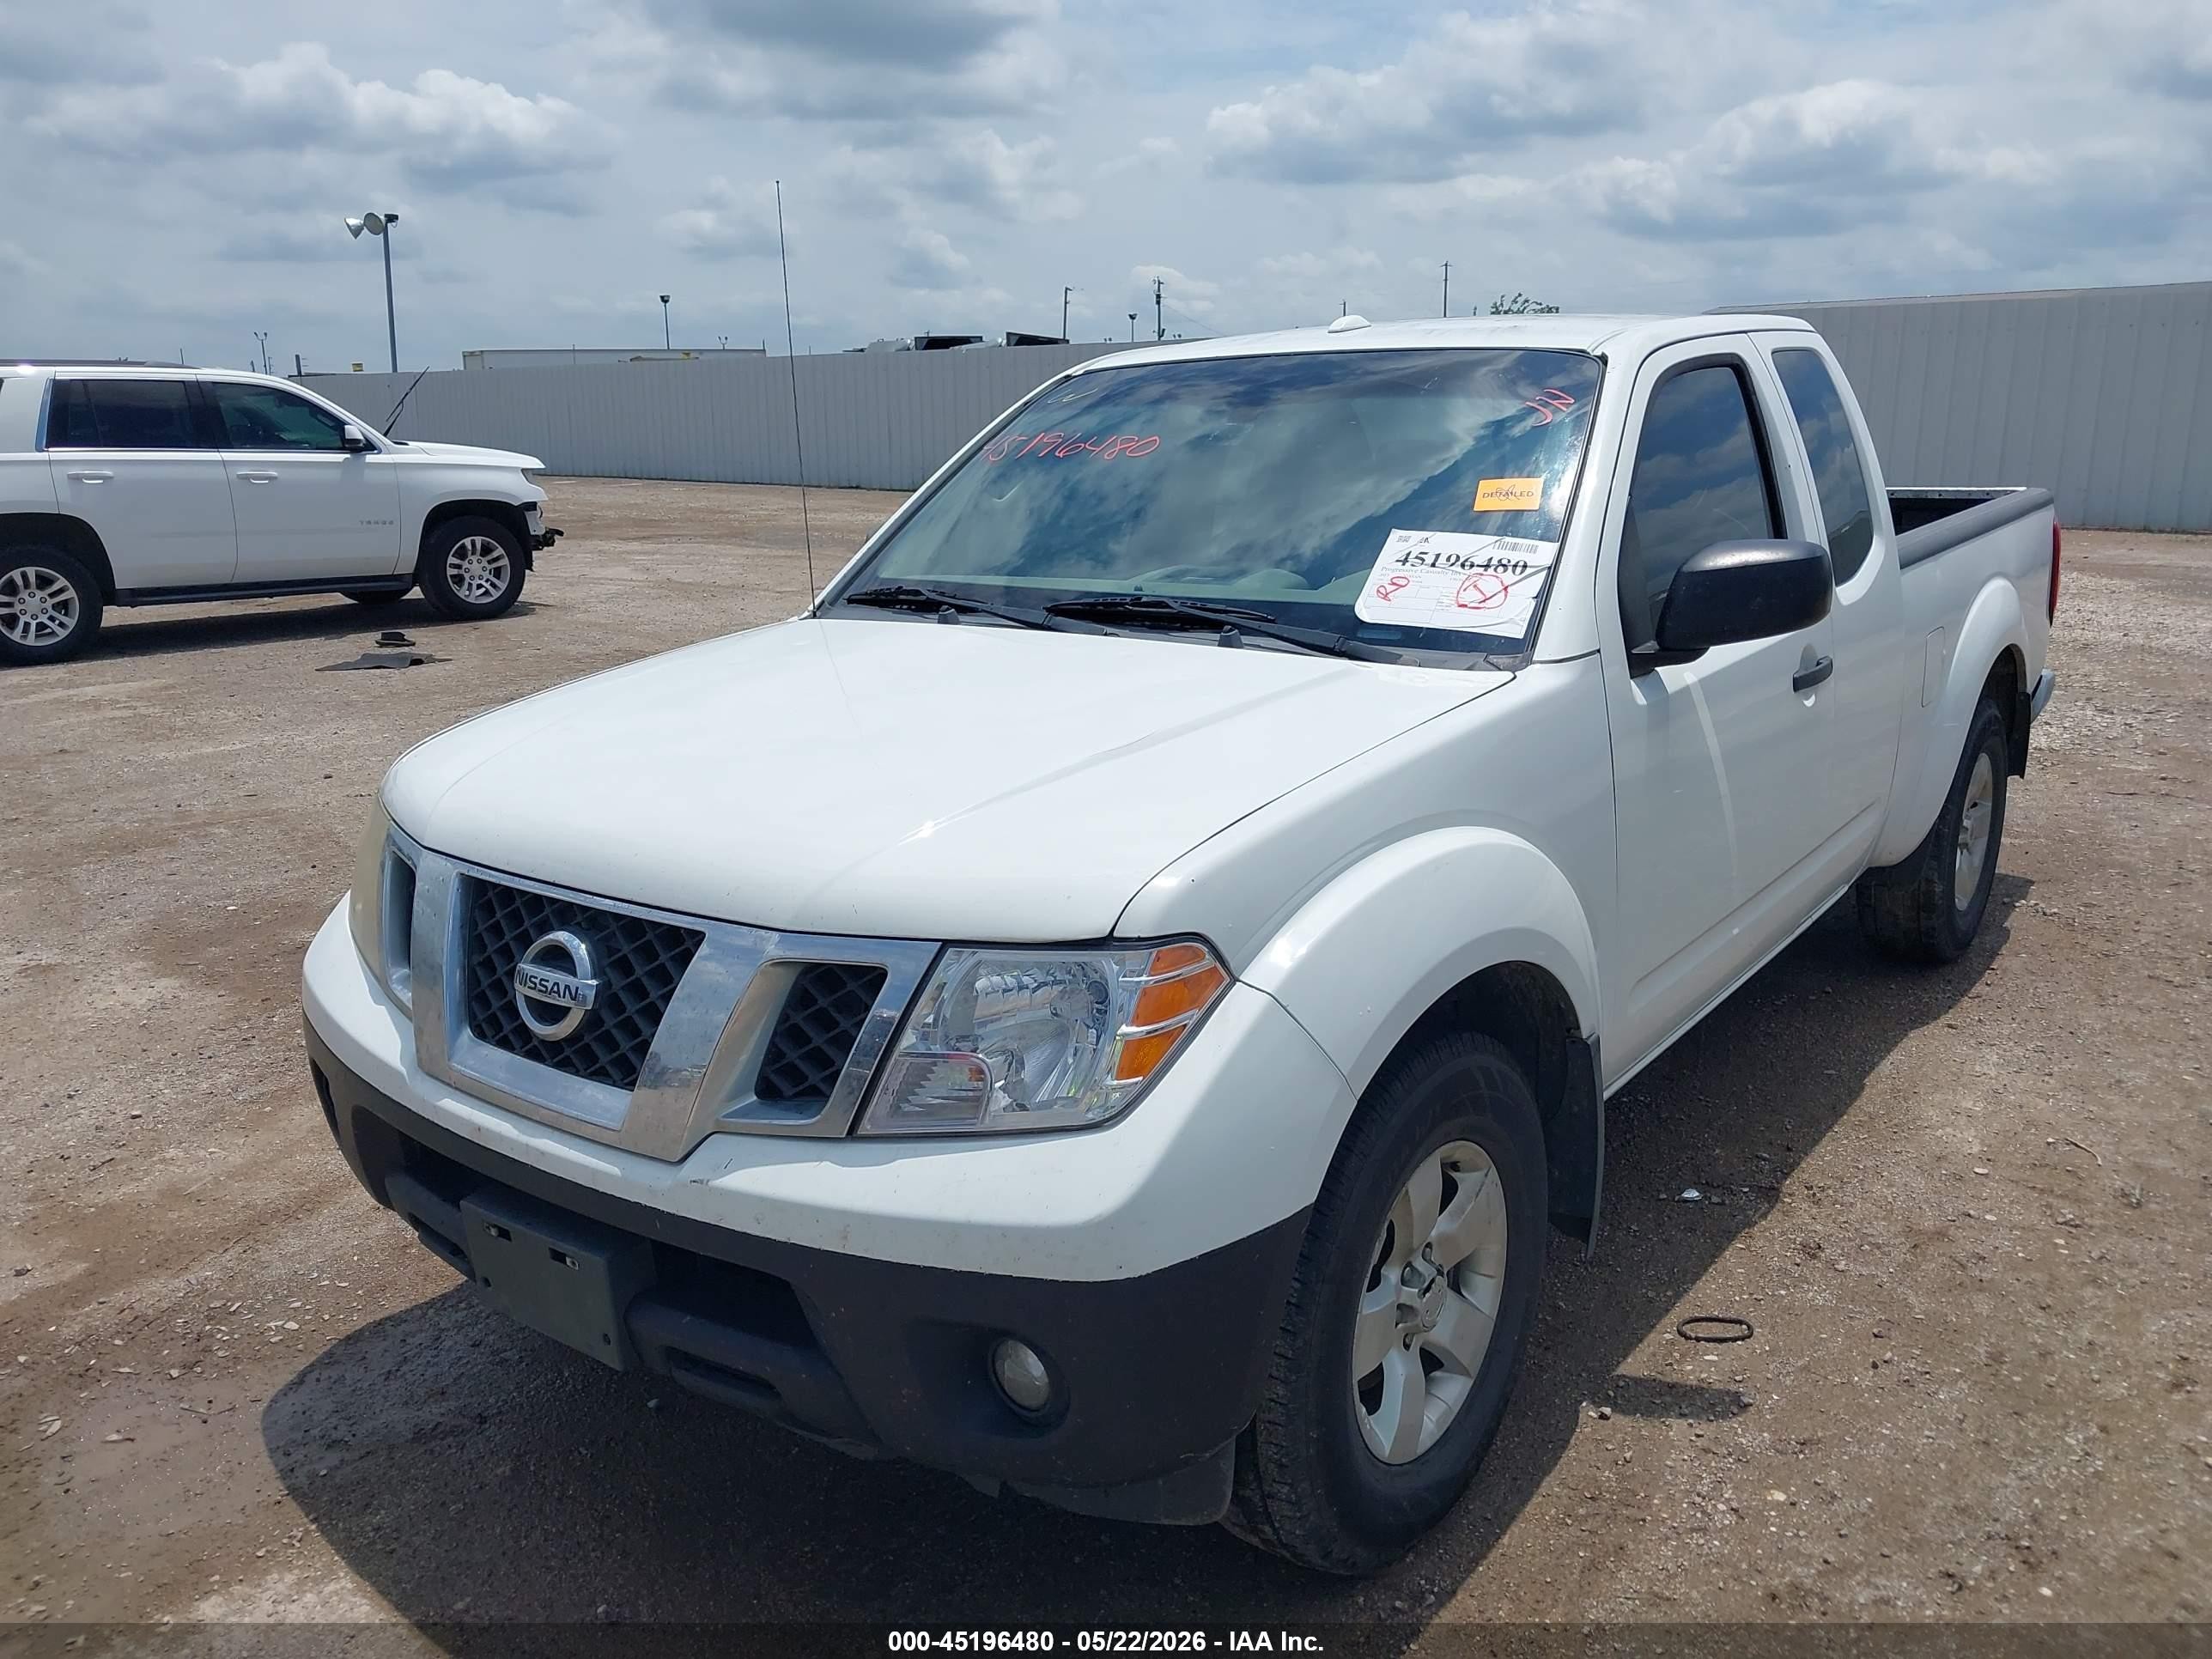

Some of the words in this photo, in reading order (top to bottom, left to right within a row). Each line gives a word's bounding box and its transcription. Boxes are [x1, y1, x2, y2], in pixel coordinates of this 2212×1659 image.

[1482, 490, 1534, 499] DETAILED
[1395, 550, 1528, 576] 45196480
[515, 966, 580, 1002] NISSAN
